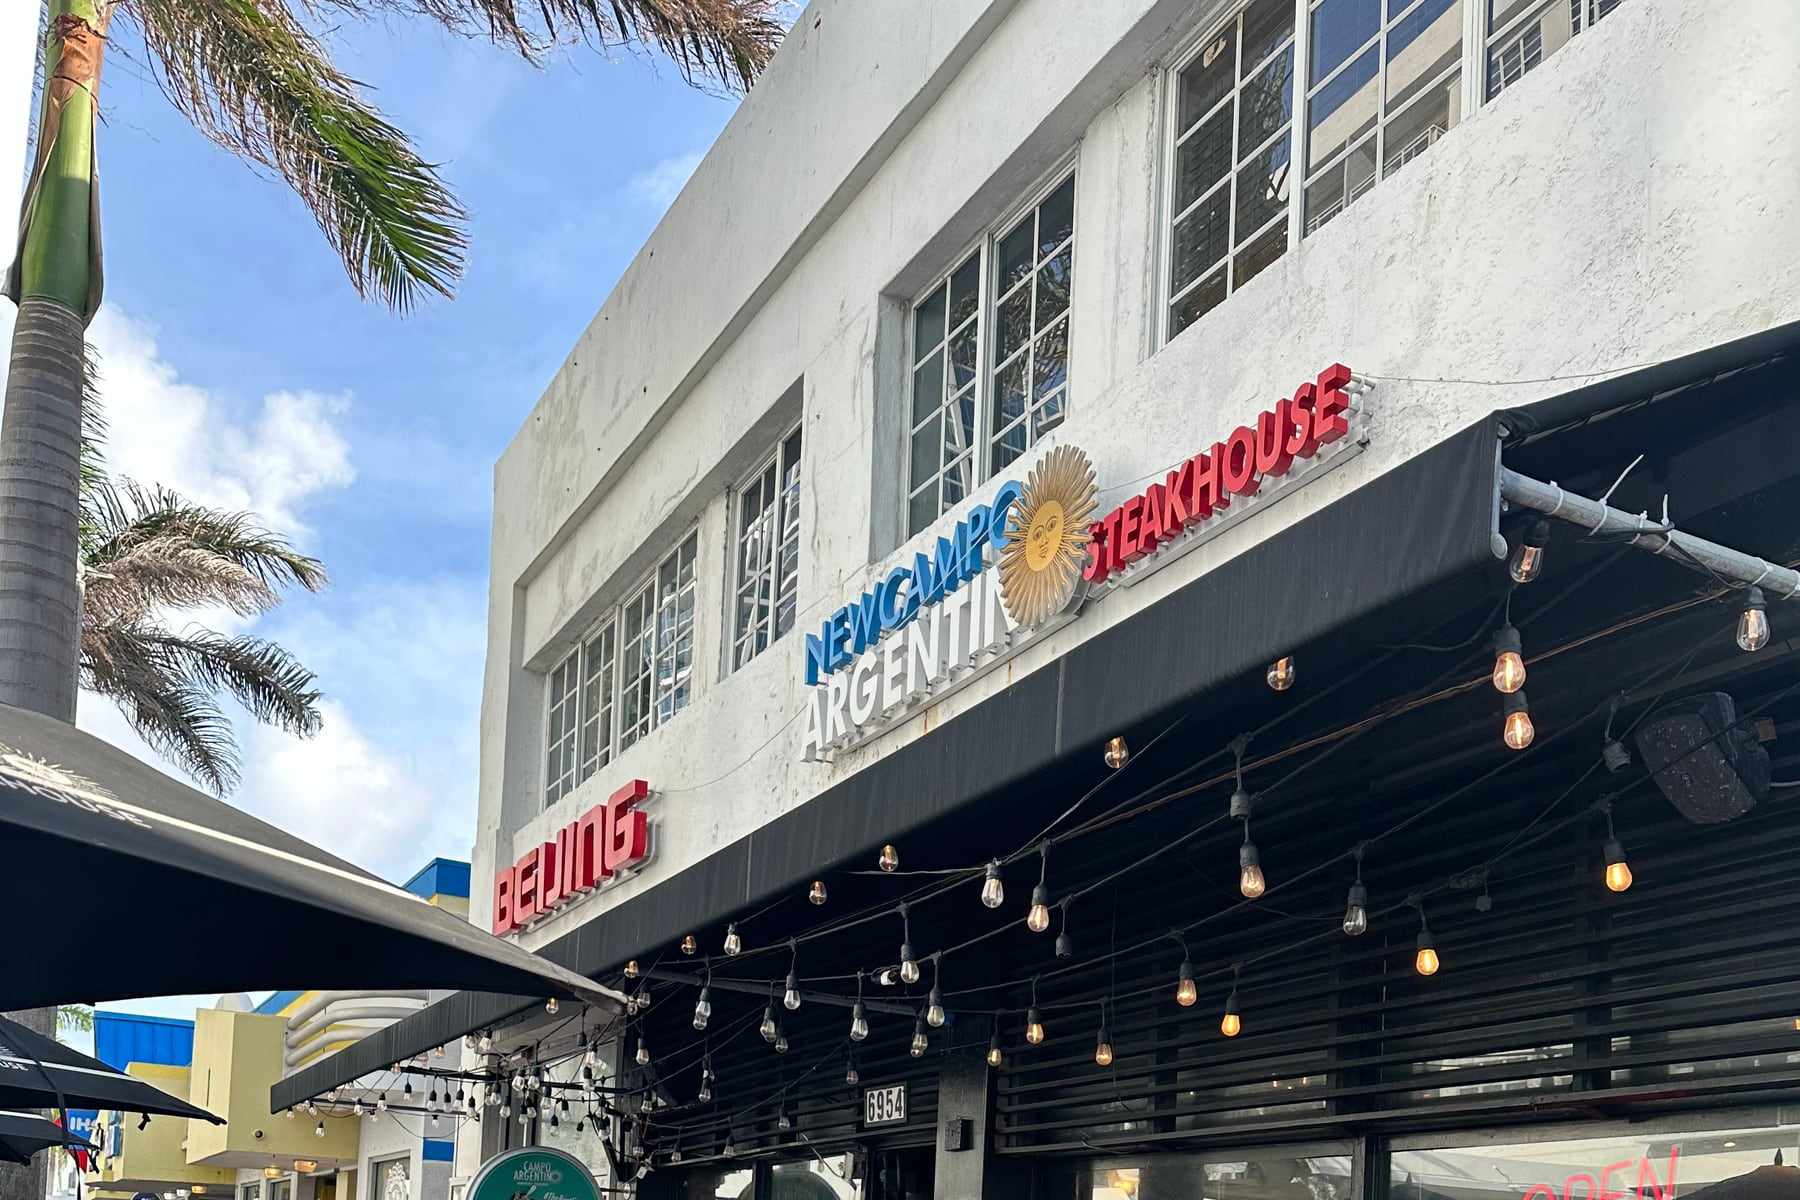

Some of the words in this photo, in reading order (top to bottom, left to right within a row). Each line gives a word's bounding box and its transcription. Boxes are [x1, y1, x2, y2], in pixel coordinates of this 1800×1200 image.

[1082, 362, 1352, 585] STEAKHOUSE
[492, 778, 649, 937] BEIJING
[868, 1087, 903, 1121] 6954
